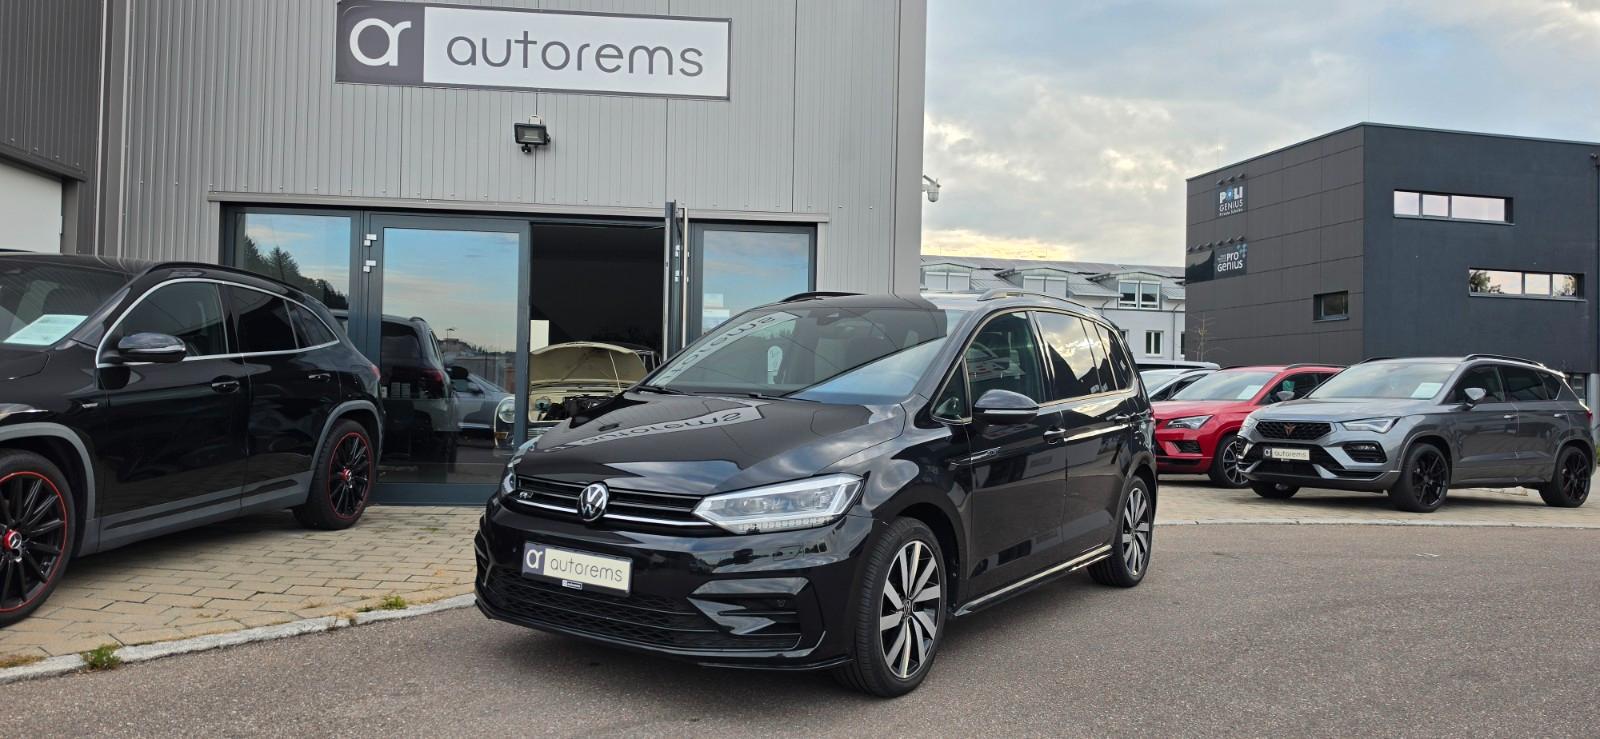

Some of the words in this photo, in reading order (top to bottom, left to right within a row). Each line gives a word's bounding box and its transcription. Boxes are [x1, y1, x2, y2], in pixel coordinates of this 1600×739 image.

[446, 30, 704, 77] autorems
[1219, 199, 1244, 212] GENIUS
[550, 557, 623, 582] autorems
